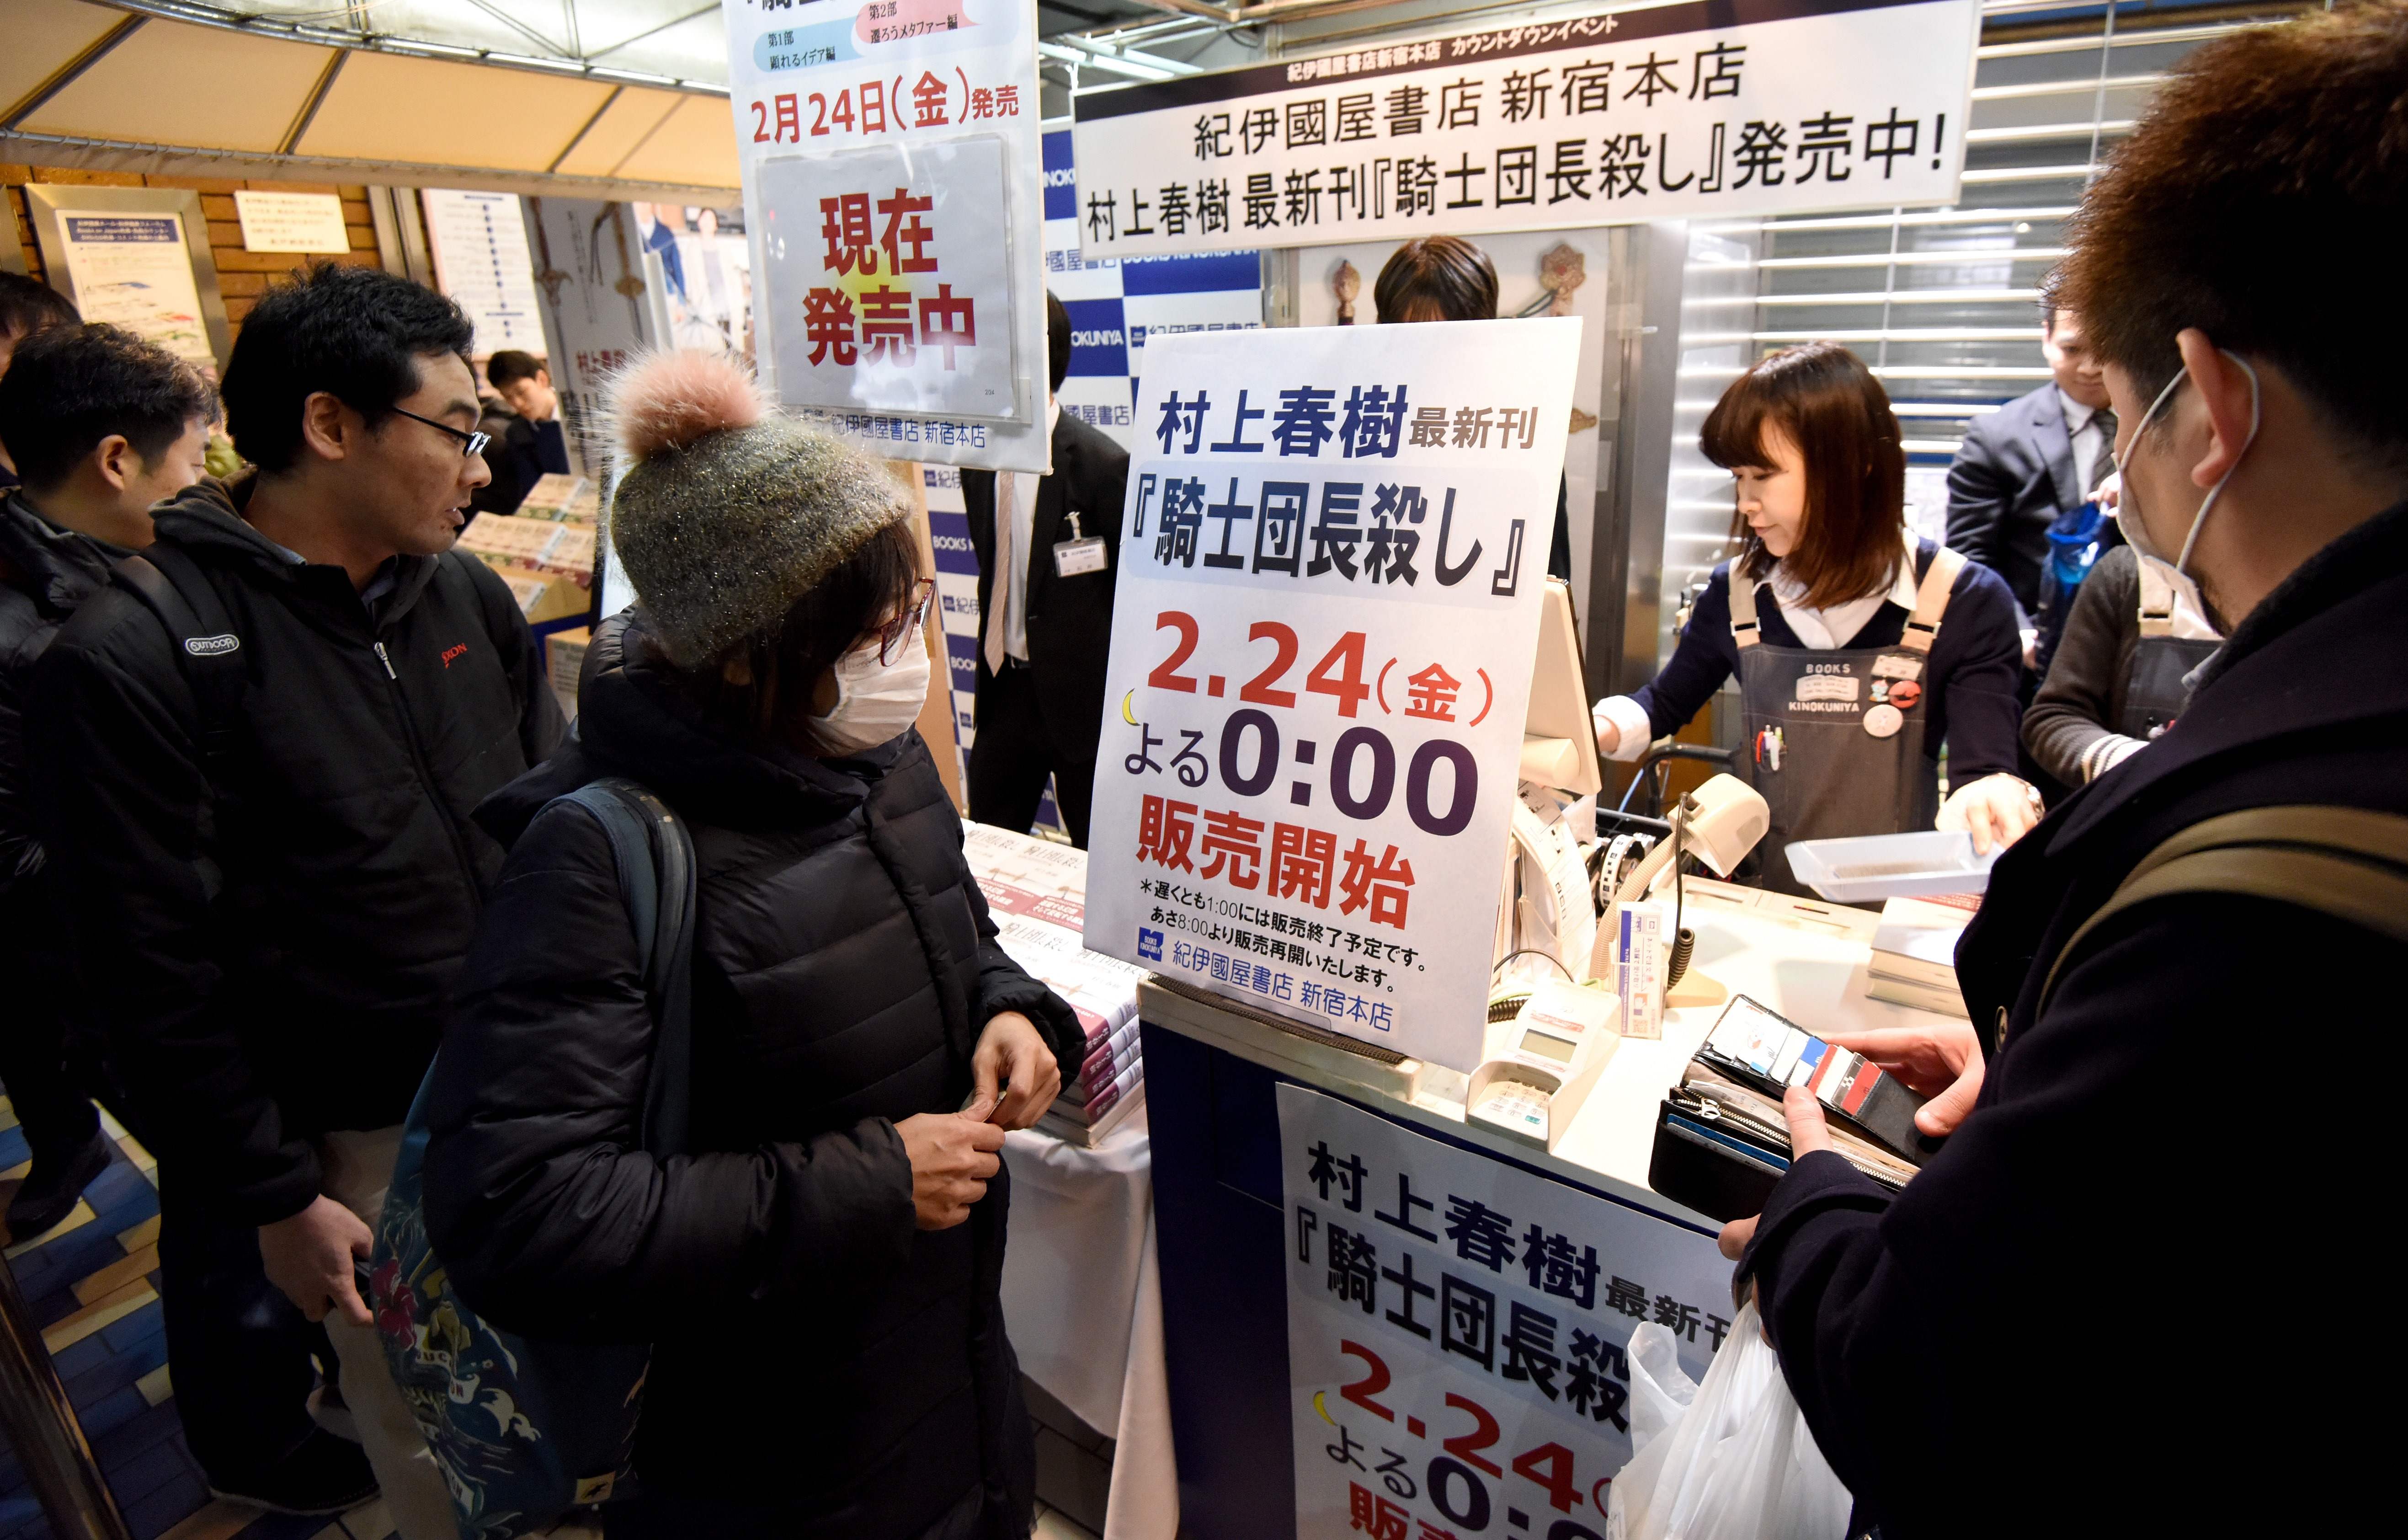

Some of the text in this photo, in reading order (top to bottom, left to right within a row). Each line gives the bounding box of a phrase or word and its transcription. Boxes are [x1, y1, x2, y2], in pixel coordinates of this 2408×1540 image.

[768, 30, 794, 48] 第1部
[869, 1, 897, 21] 第2部
[1286, 16, 1620, 83] 紀伊國屋書店新宿本店 カウントダウンイベント
[1193, 41, 1747, 161] 紀伊國屋書店 新宿本店
[819, 187, 938, 277] 現在
[1087, 177, 1231, 243] 村上春樹
[802, 283, 976, 371] 発売中
[925, 419, 986, 449] 新宿本店
[1156, 384, 1540, 459] 村上春樹 最新刊
[1132, 473, 1526, 598] 『騎士団長殺し』
[1806, 663, 1851, 674] BOOKS
[1788, 701, 1859, 712] KINOKUNIYA
[1135, 794, 1416, 930] 販売開始
[1172, 940, 1294, 1001] 紀伊國屋書店
[1300, 979, 1394, 1033] 新宿本店
[1307, 1140, 1601, 1311] 村上春樹
